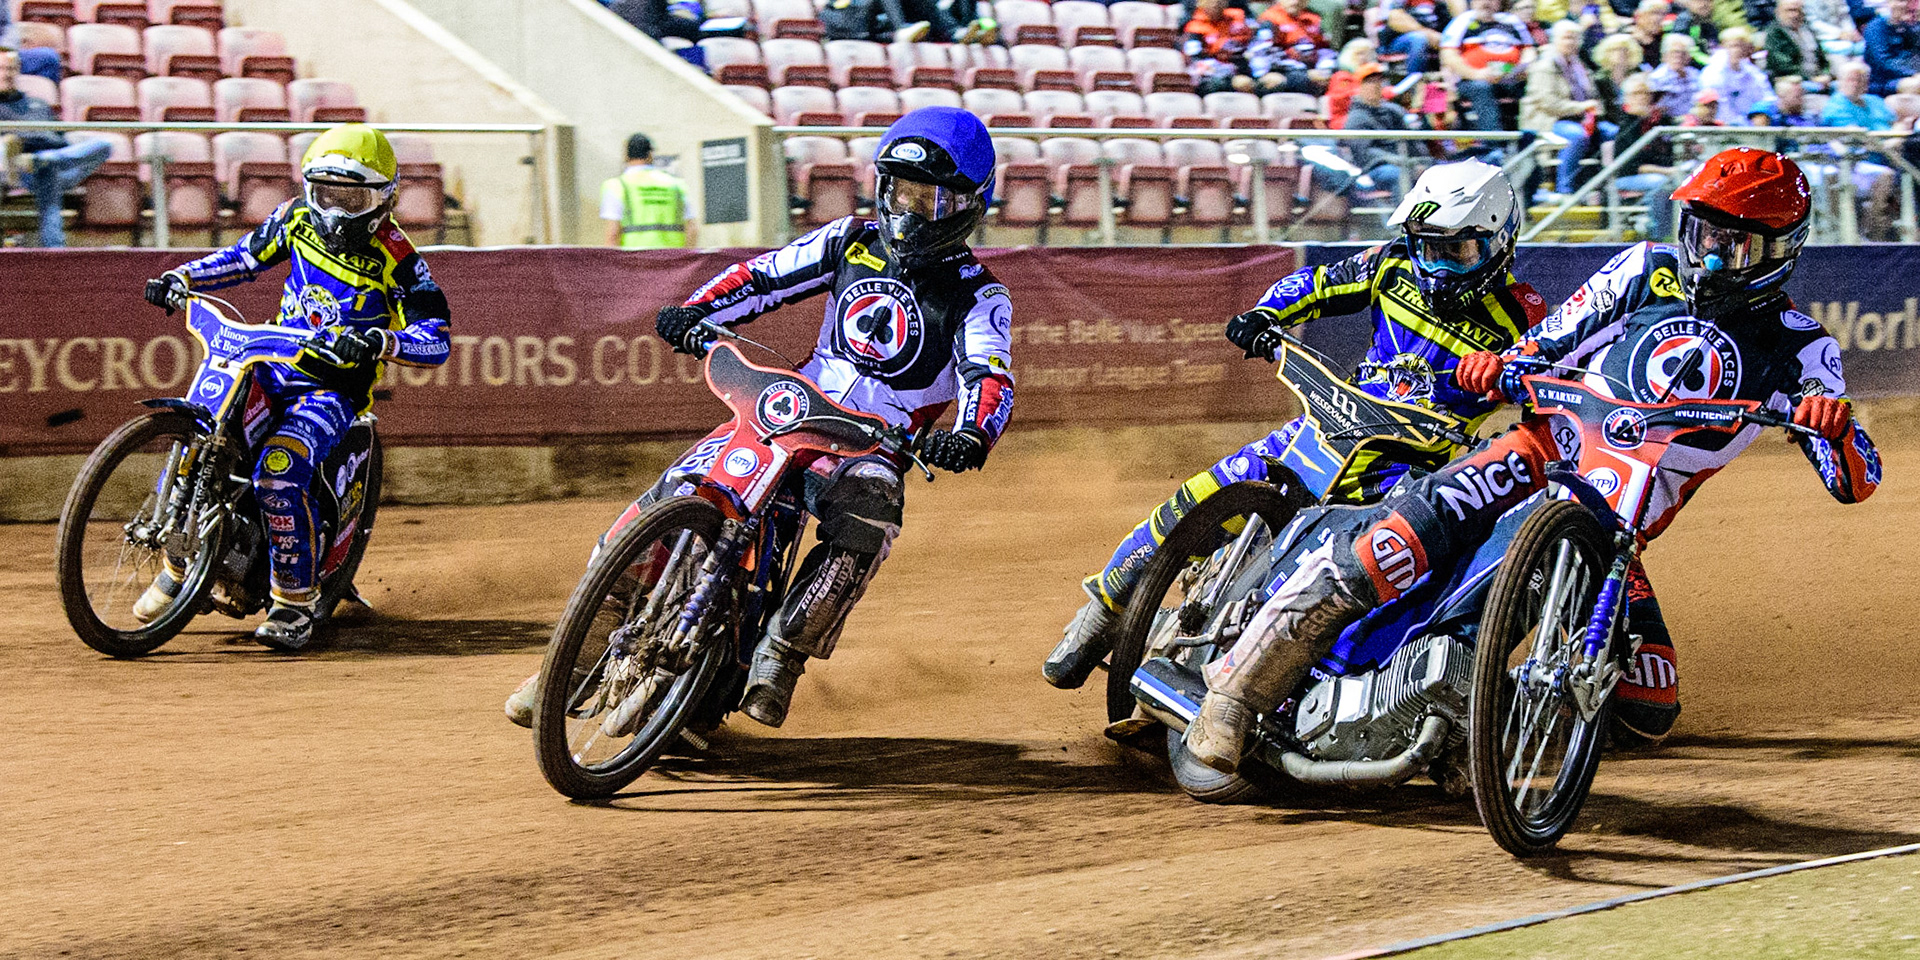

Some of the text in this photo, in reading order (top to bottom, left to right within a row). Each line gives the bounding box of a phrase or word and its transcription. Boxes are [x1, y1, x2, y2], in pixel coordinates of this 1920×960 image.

[845, 283, 919, 337] BELLE VUE ACES
[1810, 297, 1920, 351] Worl
[0, 335, 200, 393] EYCRO
[1653, 323, 1736, 388] BELLE VUE ACES
[203, 383, 221, 393] ATPI
[1547, 390, 1583, 405] WARNER
[731, 455, 752, 470] ATPI
